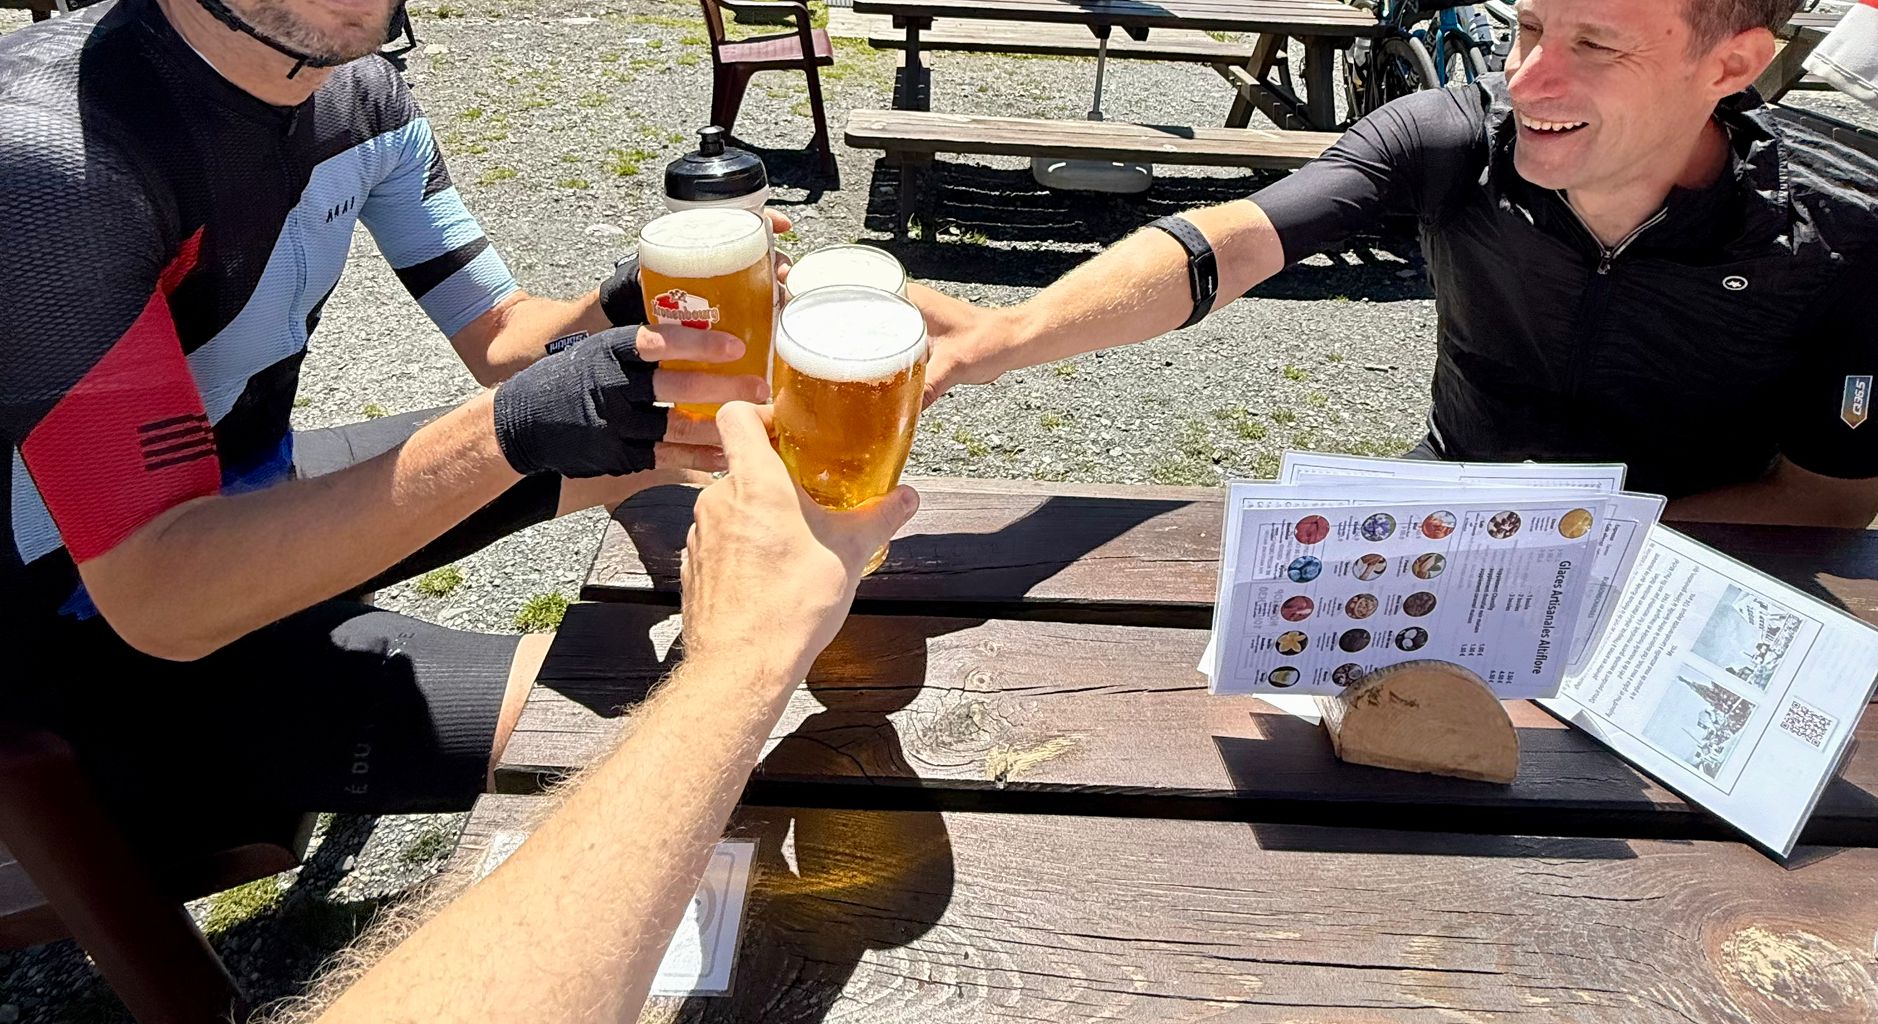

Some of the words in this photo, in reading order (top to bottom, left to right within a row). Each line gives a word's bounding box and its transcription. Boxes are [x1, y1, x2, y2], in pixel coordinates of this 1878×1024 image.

[1551, 561, 1571, 594] Glaces
[1541, 593, 1561, 640] Artisanales
[1531, 638, 1551, 675] Altiflore
